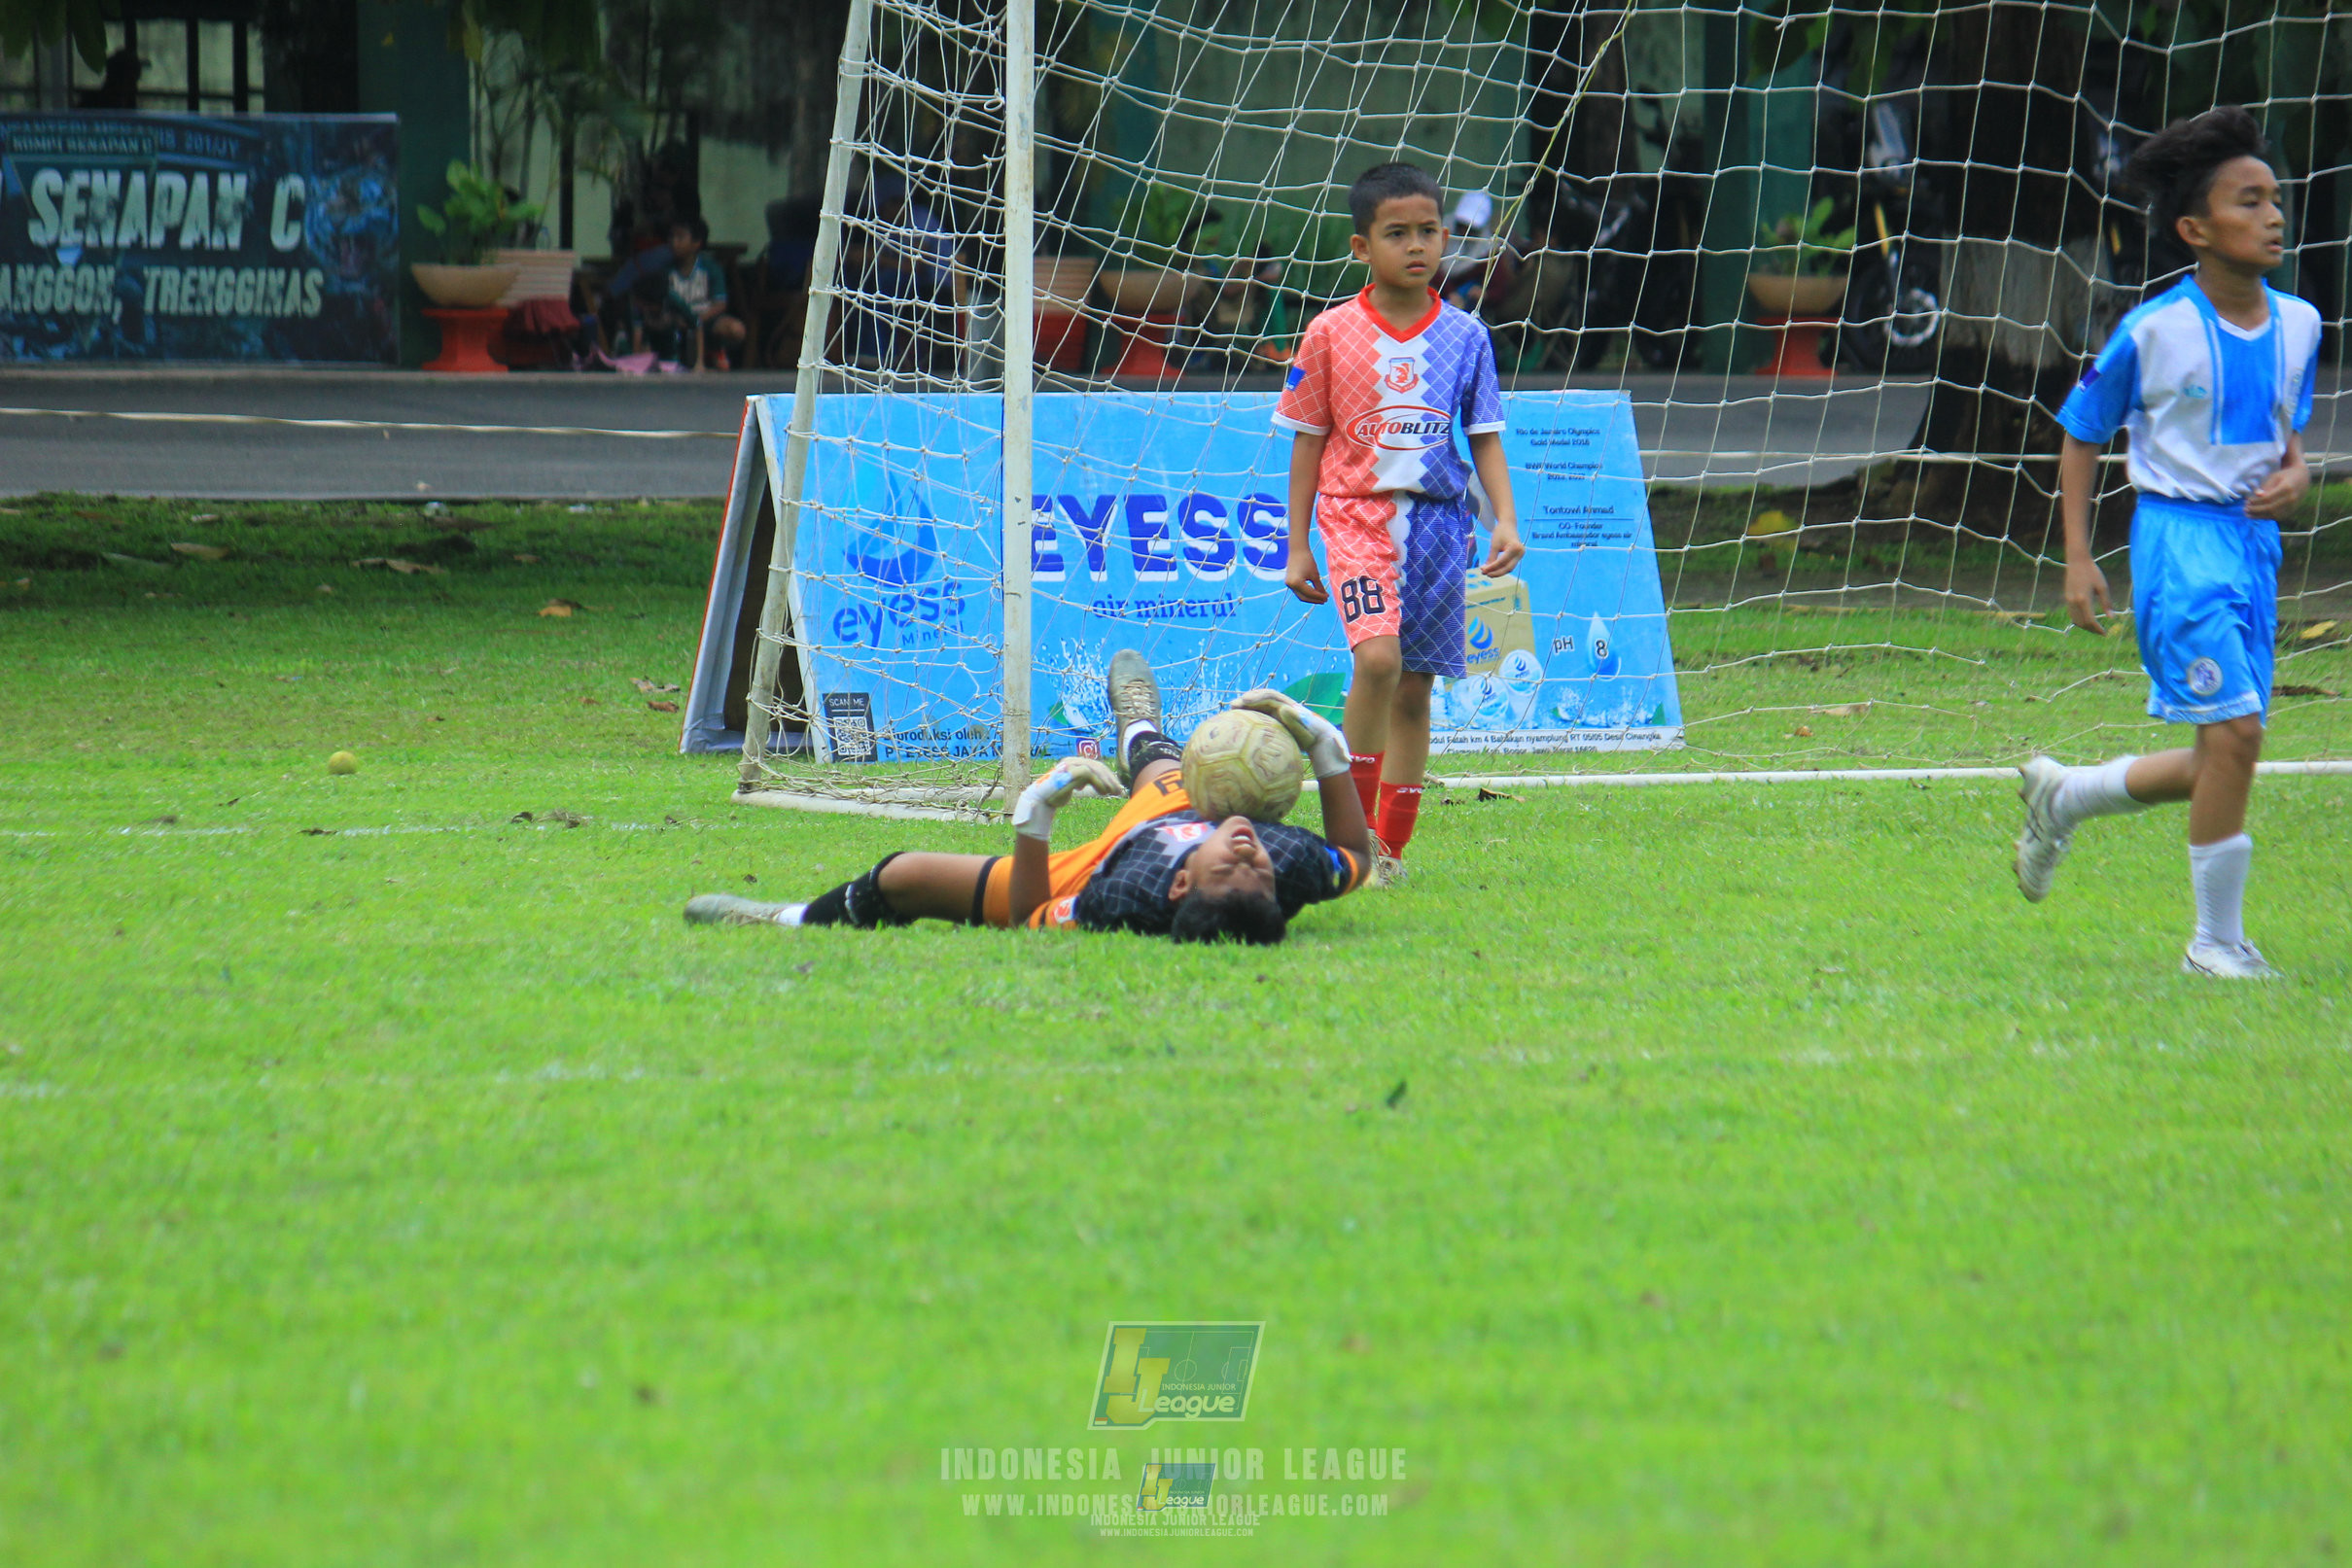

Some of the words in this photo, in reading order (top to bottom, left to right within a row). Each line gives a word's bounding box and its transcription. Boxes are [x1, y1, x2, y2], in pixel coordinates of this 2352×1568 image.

[28, 167, 248, 251] SENAPAN
[269, 173, 306, 253] C
[143, 265, 325, 318] TRENGGINAS
[832, 582, 965, 650] eyess
[1093, 593, 1128, 618] air
[1340, 575, 1387, 624] 88
[1554, 636, 1574, 654] pH
[1596, 640, 1609, 659] 8
[828, 698, 850, 707] SCAN
[853, 698, 865, 707] ME
